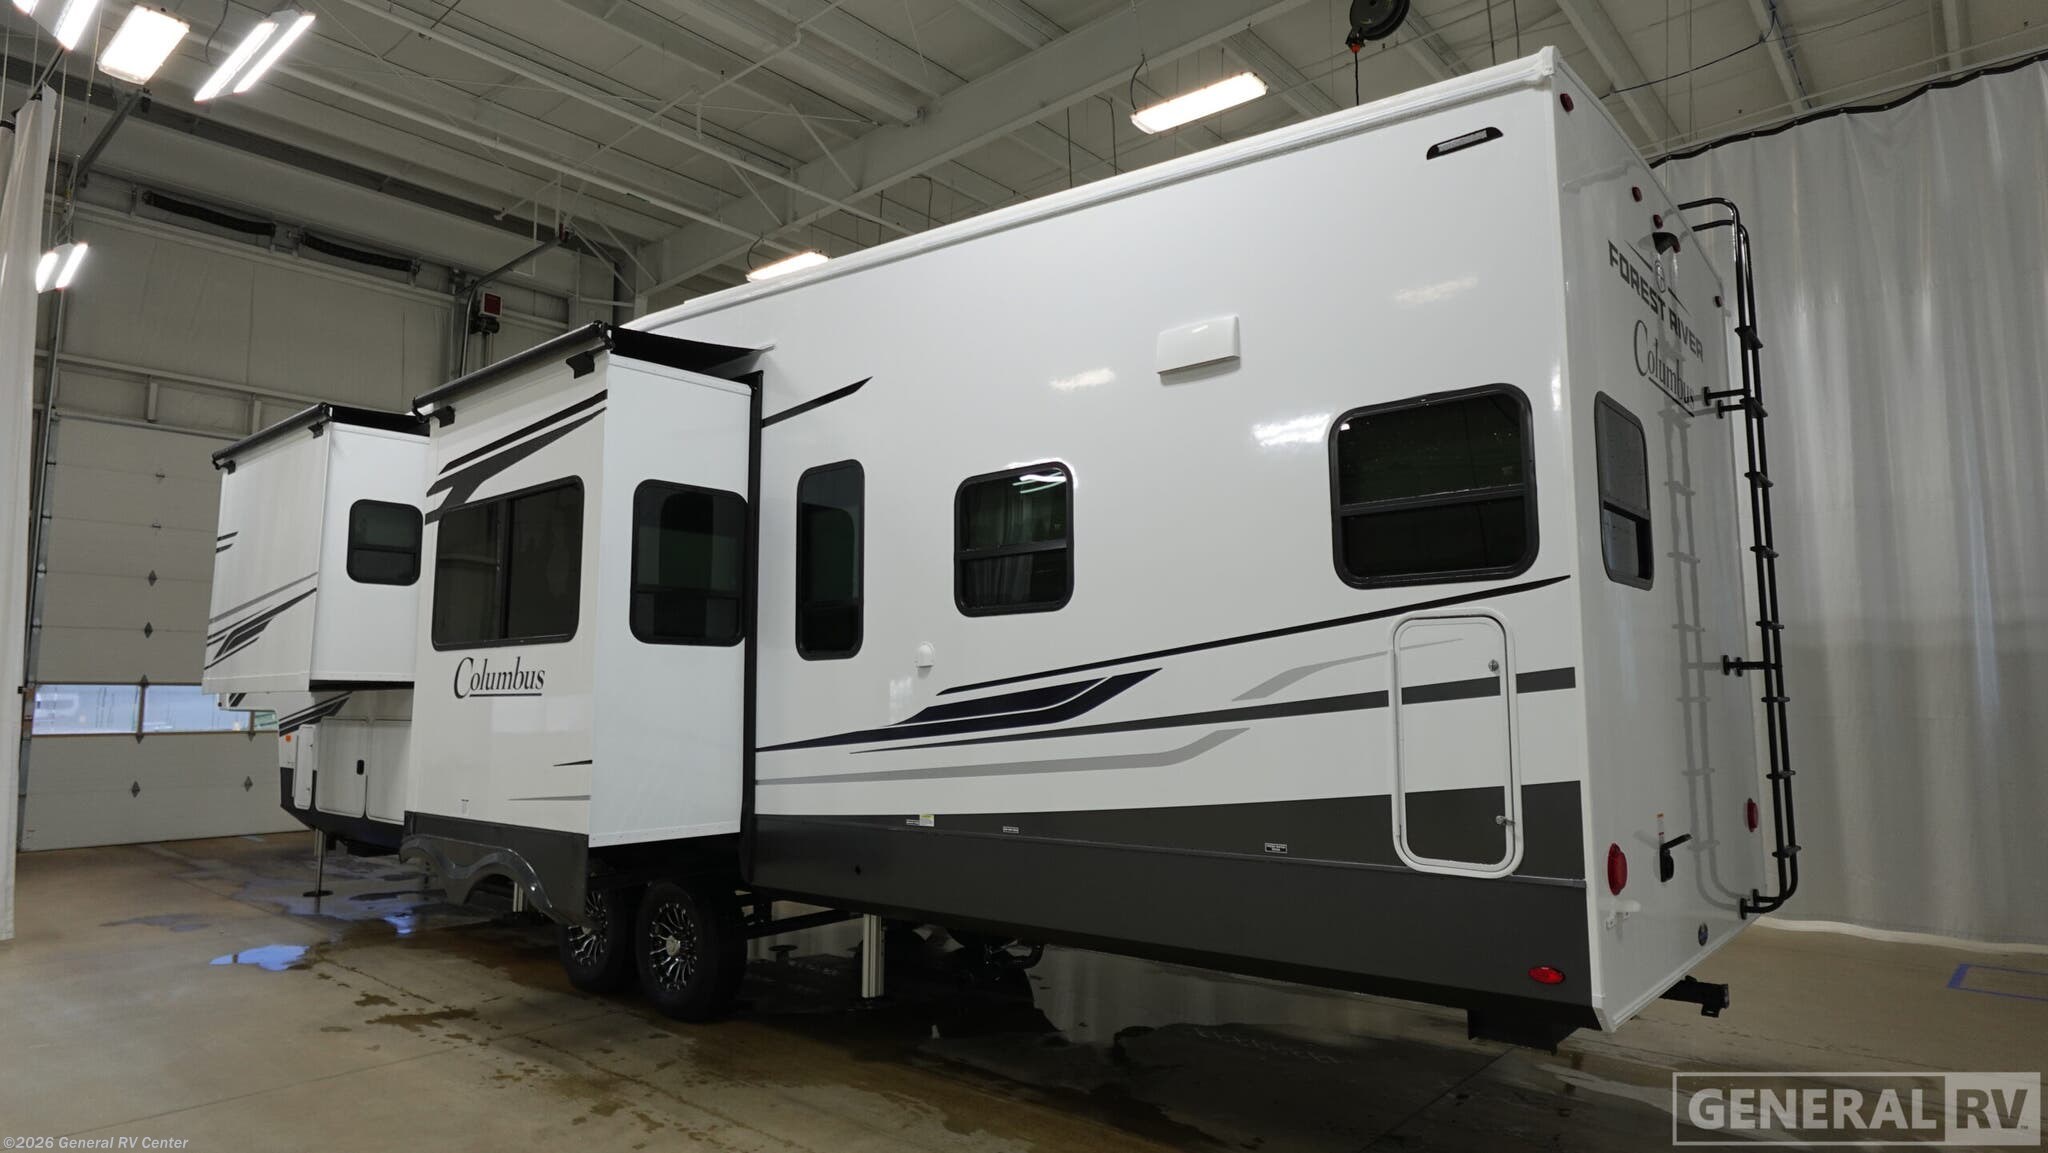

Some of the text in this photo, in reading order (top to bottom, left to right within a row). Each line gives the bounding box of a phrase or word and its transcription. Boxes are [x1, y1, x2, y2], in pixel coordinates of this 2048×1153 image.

[1608, 240, 1704, 363] FOREST RIVER
[1634, 319, 1695, 410] Columbus
[453, 656, 545, 699] Columbus
